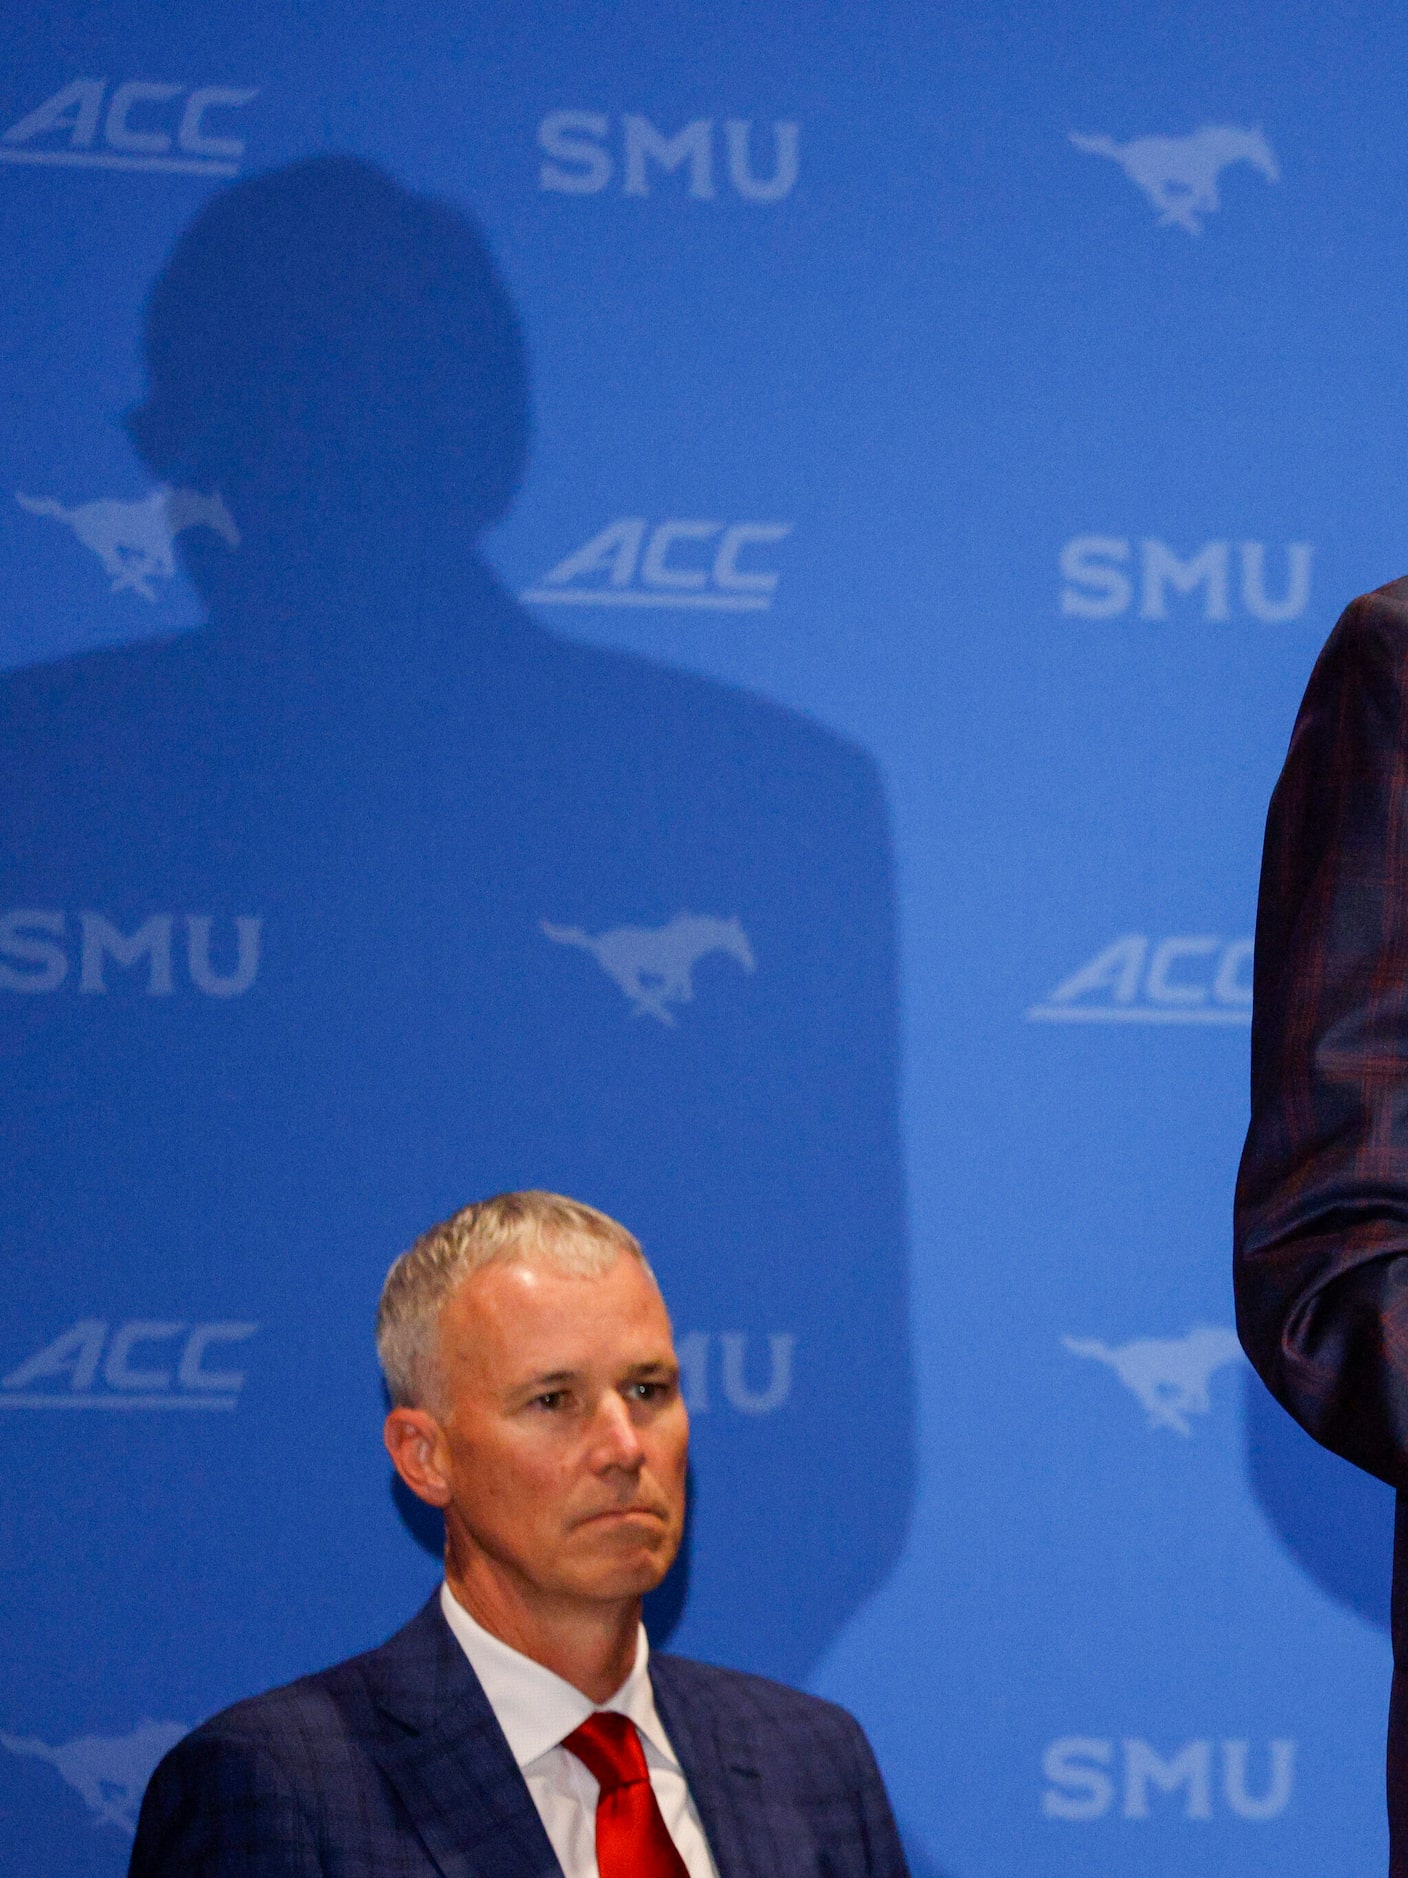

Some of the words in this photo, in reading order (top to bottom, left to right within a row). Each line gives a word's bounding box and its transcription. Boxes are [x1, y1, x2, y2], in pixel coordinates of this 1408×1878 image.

[2, 77, 260, 156] ACC
[538, 109, 800, 201] SMU
[544, 517, 793, 589] ACC
[1060, 536, 1314, 623] SMU
[0, 910, 262, 997] SMU
[4, 1321, 258, 1391] ACC
[1043, 1738, 1298, 1821] SMU
